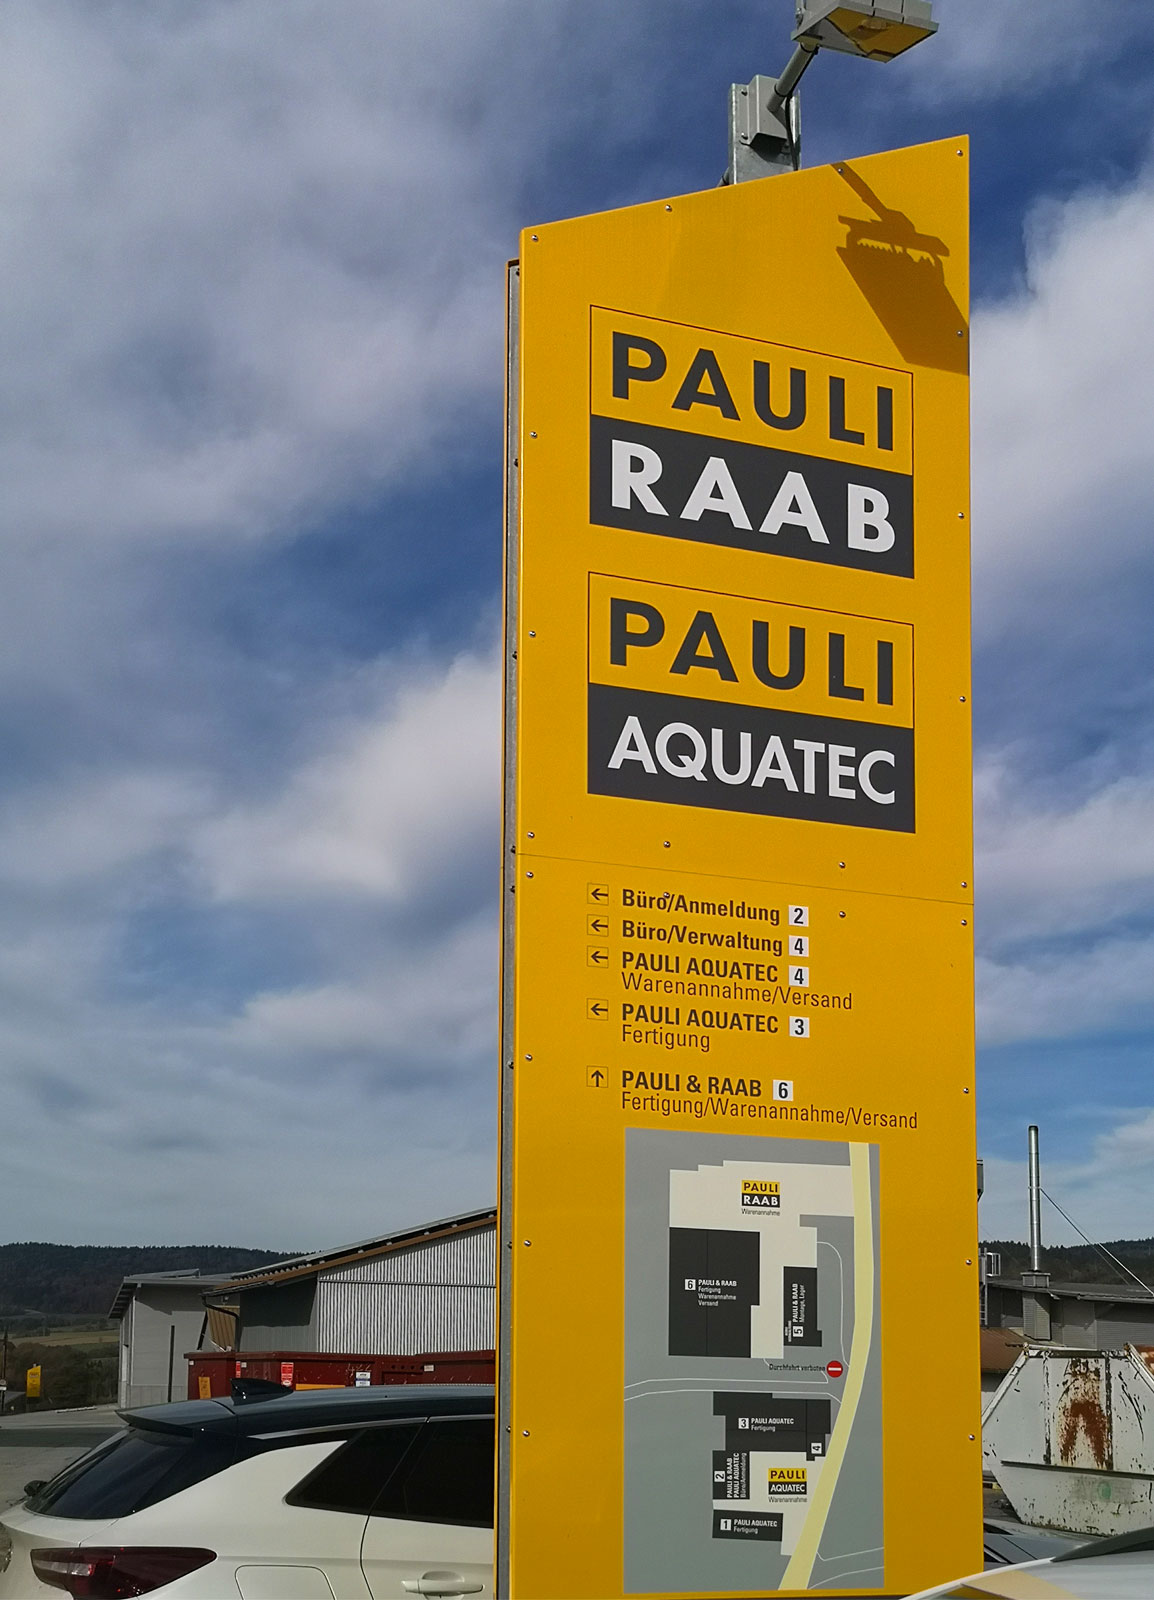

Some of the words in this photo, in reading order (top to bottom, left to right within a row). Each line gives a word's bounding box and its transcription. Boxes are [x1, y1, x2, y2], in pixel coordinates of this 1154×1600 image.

[611, 331, 894, 451] PAULI
[611, 439, 895, 553] RAAB
[610, 597, 894, 706] PAULI
[607, 715, 895, 804] AQUATEC
[622, 888, 780, 926] Büro/Anmeldung
[794, 908, 804, 925] 2
[622, 920, 783, 957] Büro/Verwaltung
[794, 939, 804, 954] 4
[622, 951, 680, 973] PAULI
[686, 957, 779, 983] AQUATEC
[794, 968, 804, 984] 4
[621, 971, 852, 1010] Warenannahme/Versand
[622, 1003, 680, 1026] PAULI
[686, 1009, 779, 1034] AQUATEC
[794, 1018, 804, 1035] 3
[622, 1024, 711, 1052] Fertigung
[622, 1070, 680, 1092] PAULI
[686, 1074, 701, 1094] &
[708, 1077, 762, 1097] RAAB
[778, 1082, 788, 1099] 6
[622, 1091, 918, 1129] Fertigung/Warenannahme/Versand
[743, 1182, 778, 1193] PAULI
[743, 1195, 779, 1206] RAAB
[698, 1286, 721, 1294] Fertigung
[741, 1419, 747, 1428] 3
[770, 1470, 805, 1479] PAULI
[770, 1484, 805, 1493] AQUATEC
[723, 1520, 728, 1529] 1
[751, 1519, 778, 1527] AQUATEC
[733, 1526, 758, 1534] Fertigung
